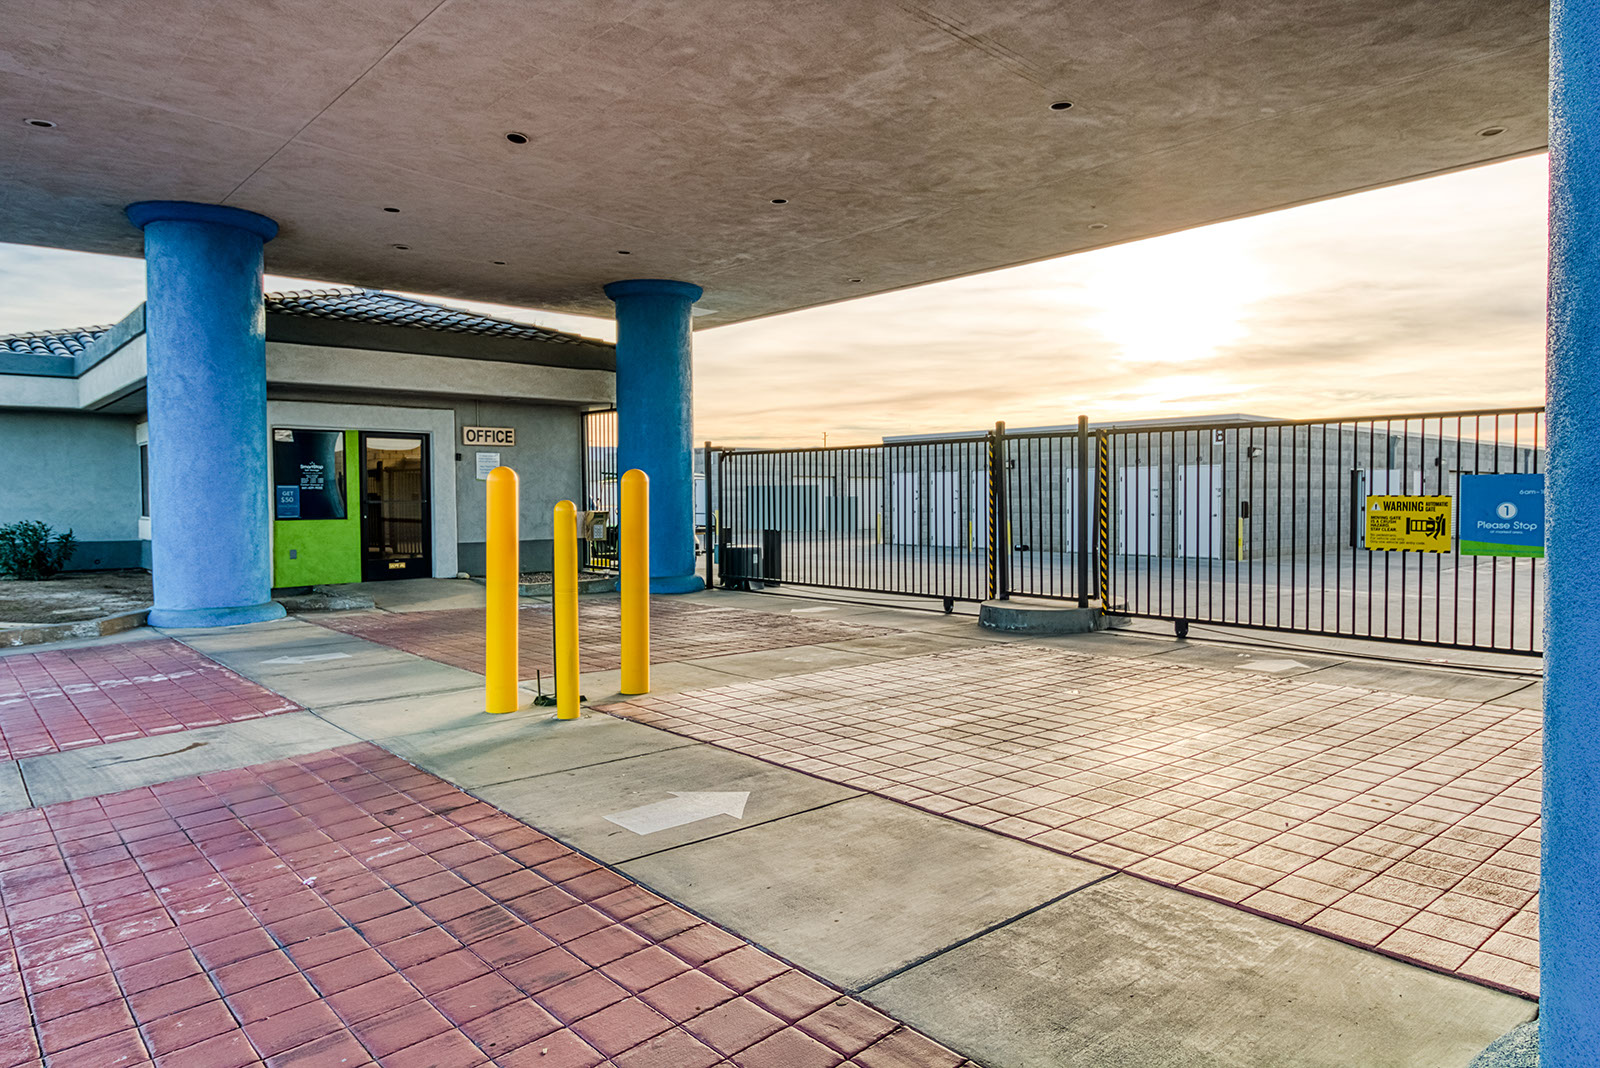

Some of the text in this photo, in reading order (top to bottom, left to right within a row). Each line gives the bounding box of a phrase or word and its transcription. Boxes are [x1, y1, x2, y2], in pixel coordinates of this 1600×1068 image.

[466, 429, 513, 443] OFFICE
[1383, 501, 1424, 512] WARNING
[1504, 505, 1509, 516] 1
[1477, 521, 1538, 532] Please Stop
